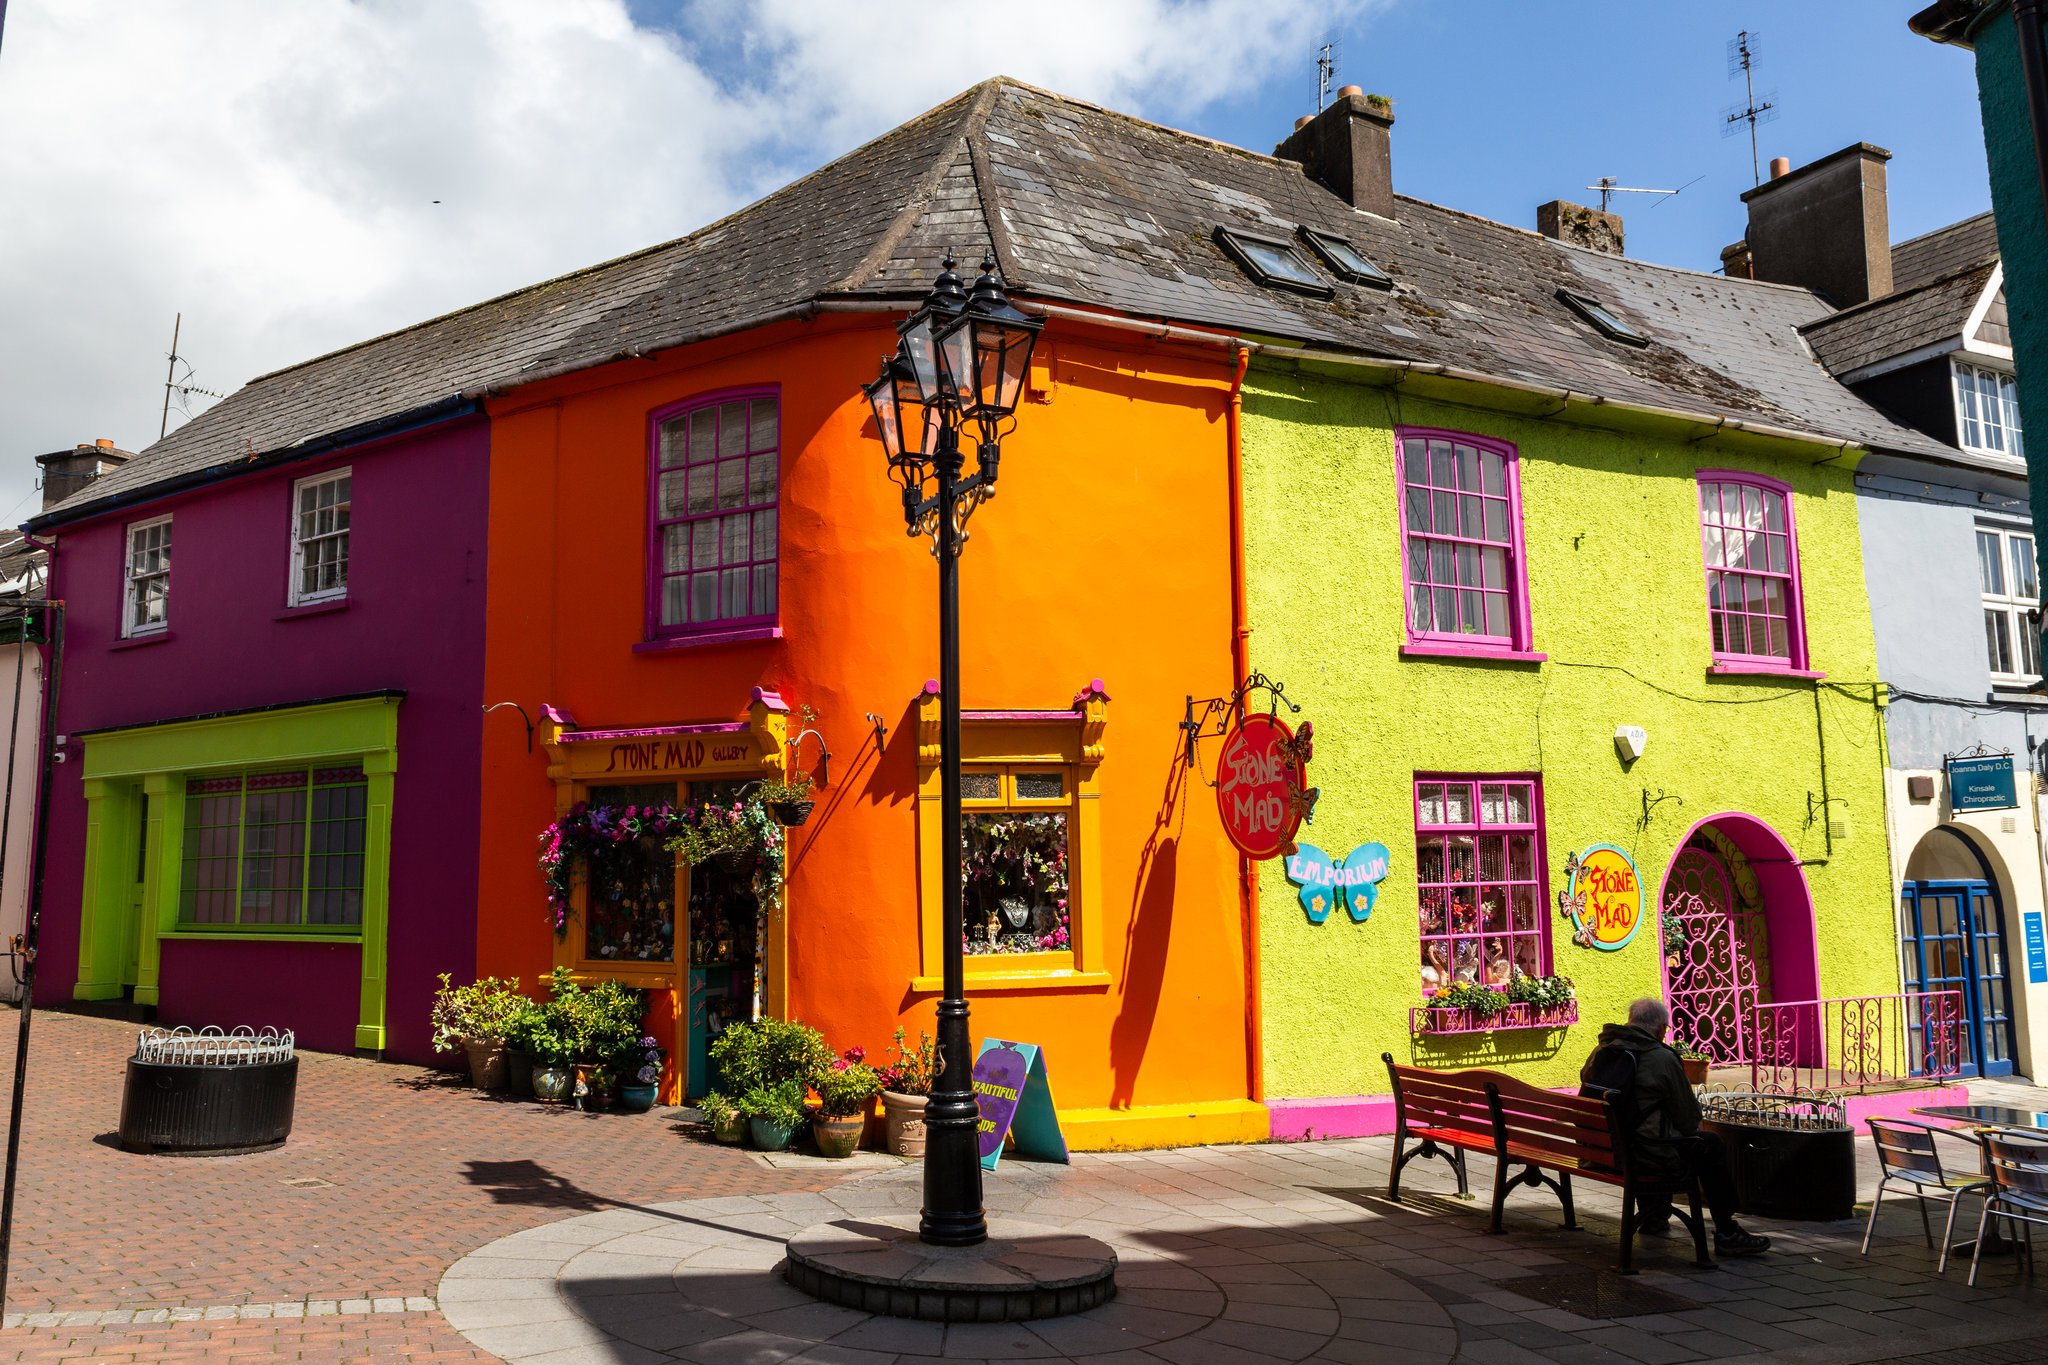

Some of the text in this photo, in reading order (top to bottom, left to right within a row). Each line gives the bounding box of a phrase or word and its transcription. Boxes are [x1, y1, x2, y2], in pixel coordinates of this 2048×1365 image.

[605, 740, 748, 772] STONE MAD GALLERY
[1223, 737, 1284, 799] STONE
[1978, 764, 1994, 772] Daly
[1962, 794, 2006, 804] Chiropractic
[1968, 785, 1996, 793] Kinsale
[1233, 792, 1284, 834] MAD
[1288, 855, 1389, 887] EMPORIUM
[1590, 865, 1634, 904] STONE
[1593, 896, 1632, 930] MAD
[972, 1081, 1018, 1101] EAUTIFUL
